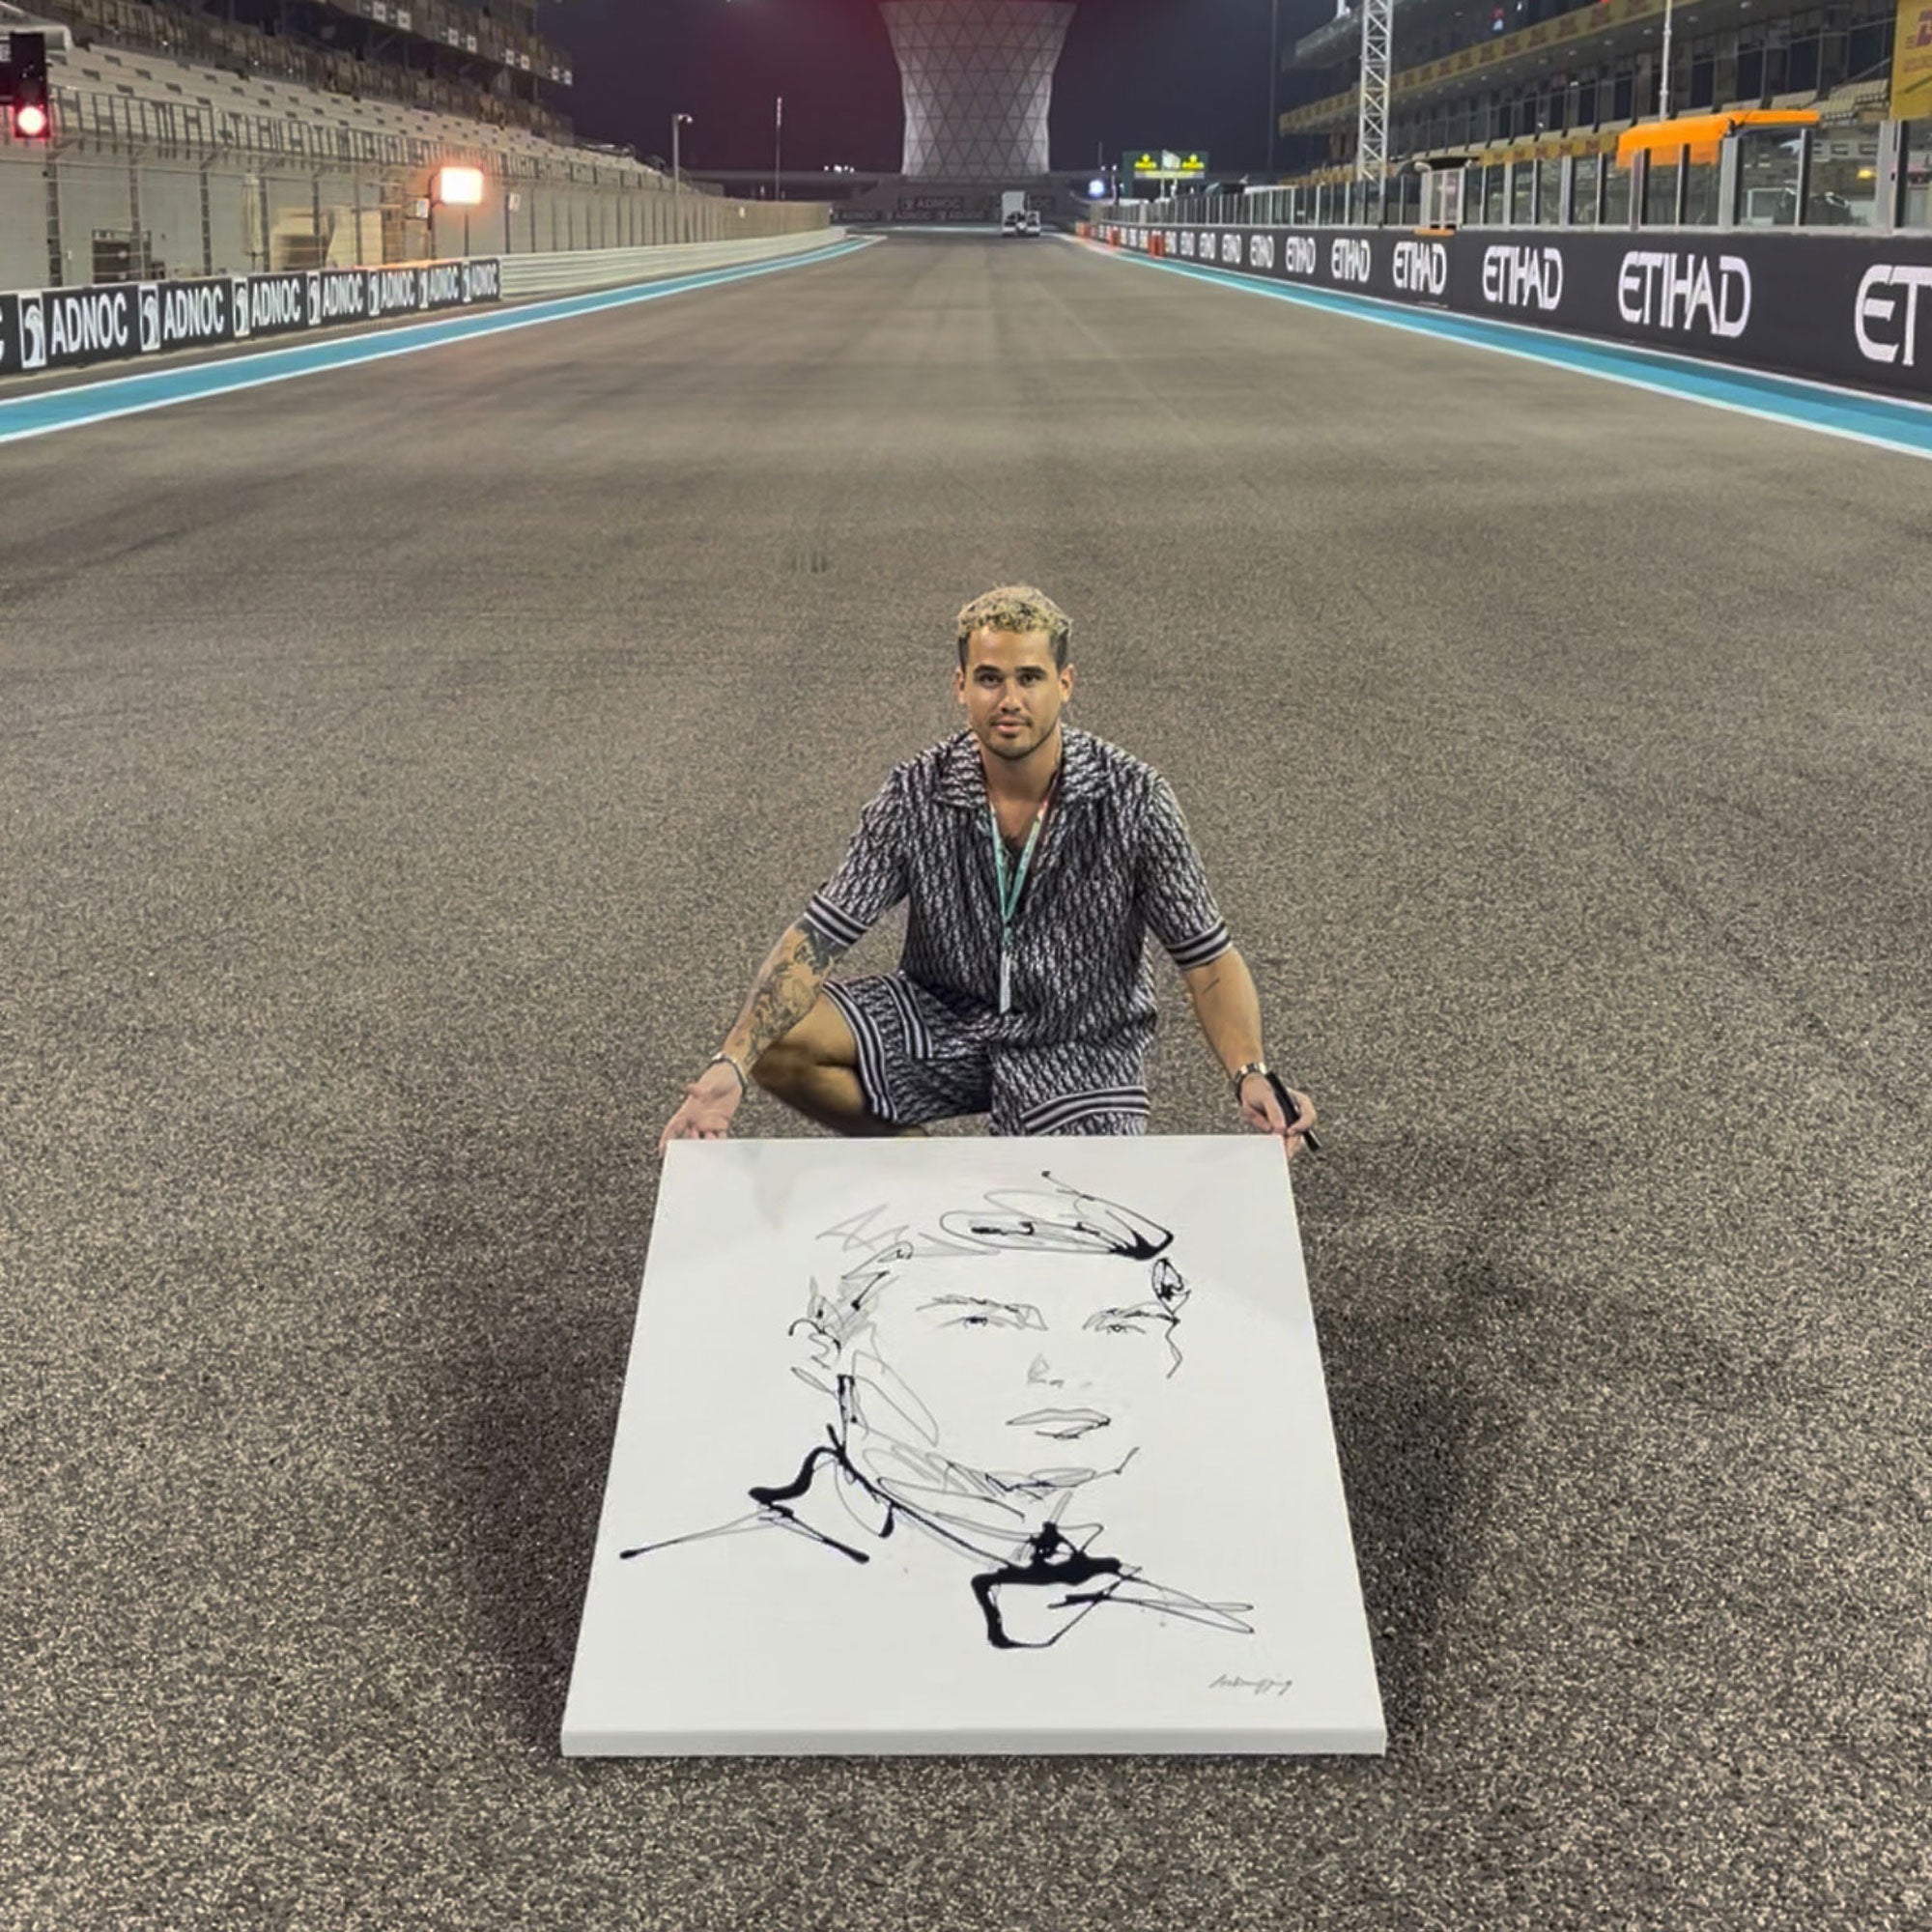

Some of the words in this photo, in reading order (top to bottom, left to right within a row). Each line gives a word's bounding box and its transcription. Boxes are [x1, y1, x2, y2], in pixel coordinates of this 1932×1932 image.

[1331, 238, 1371, 283] ETIHAD
[1392, 241, 1447, 295] ETIHAD
[1483, 244, 1563, 310] ETIHAD
[163, 285, 224, 340] ADNOC
[251, 277, 301, 327] ADNOC
[323, 272, 363, 317] ADNOC
[1617, 250, 1751, 338] ETIHAD
[51, 292, 128, 355] ADNOC
